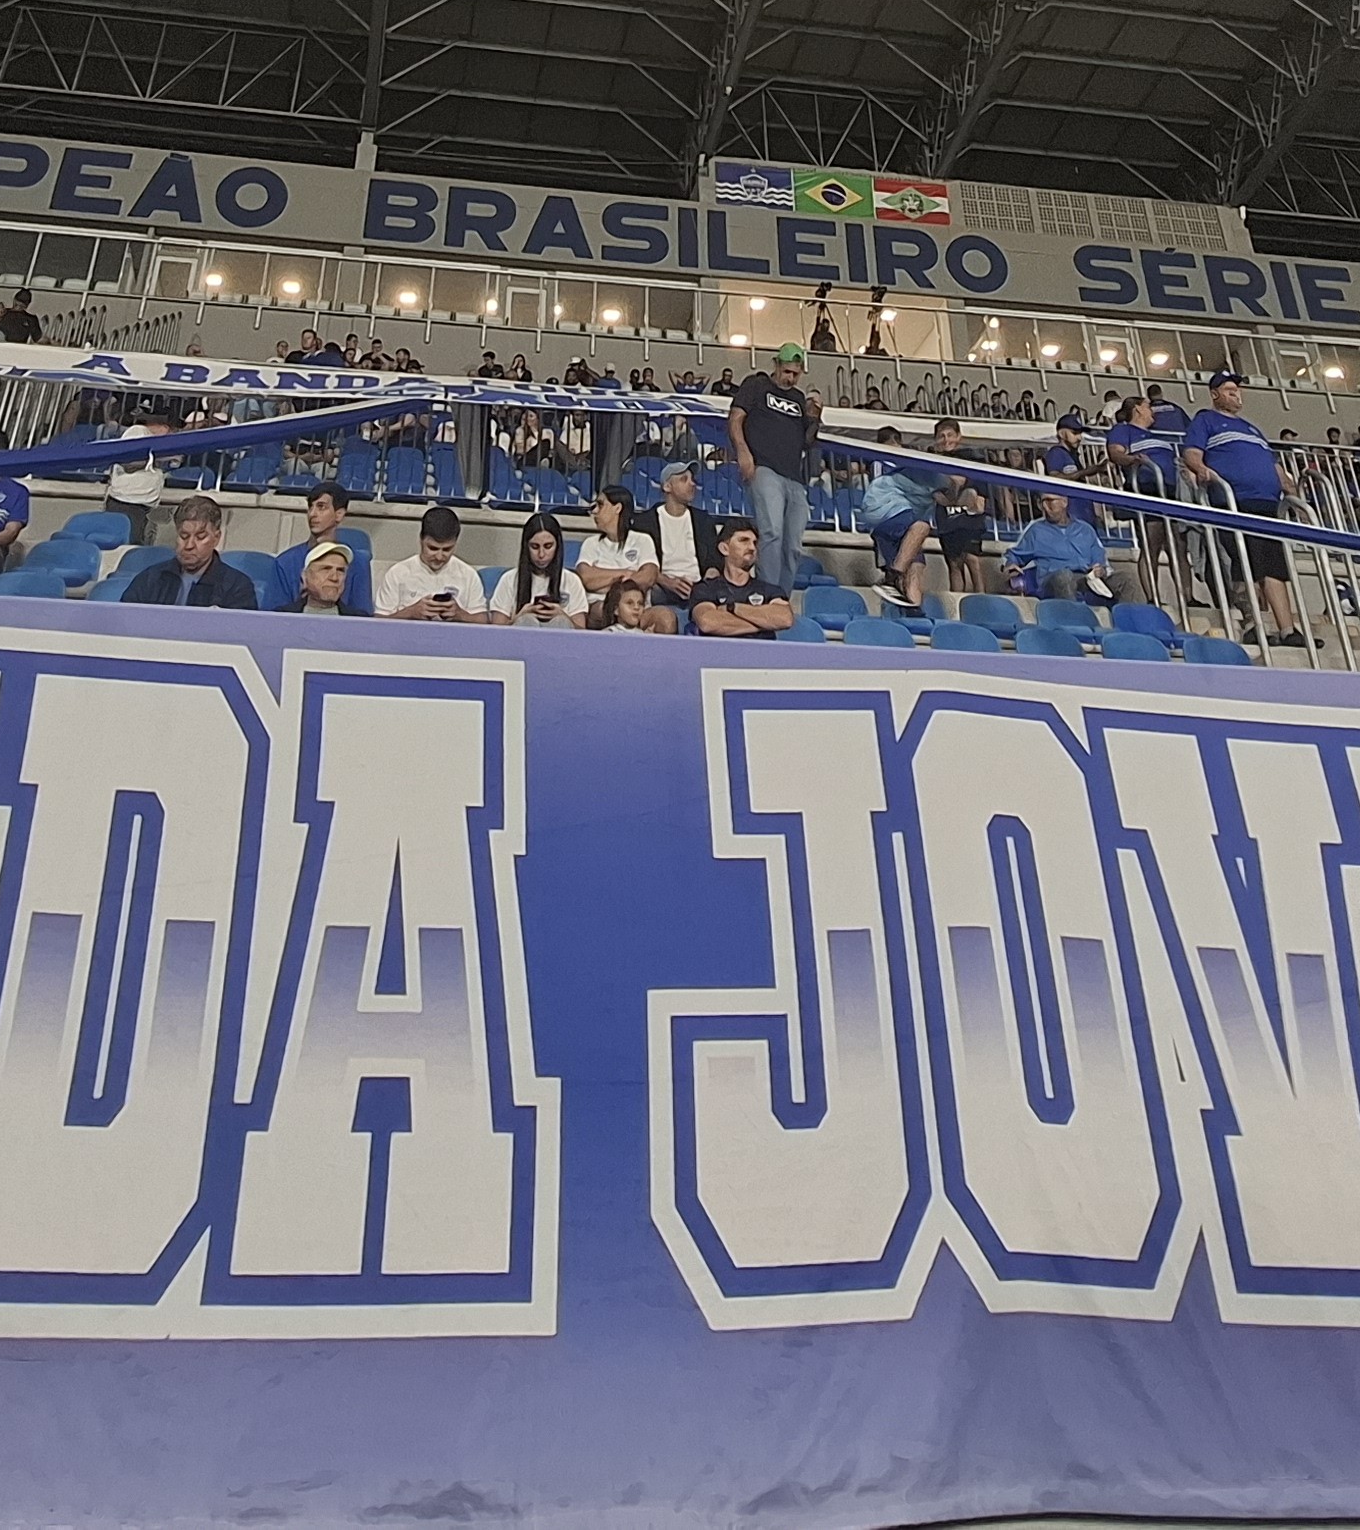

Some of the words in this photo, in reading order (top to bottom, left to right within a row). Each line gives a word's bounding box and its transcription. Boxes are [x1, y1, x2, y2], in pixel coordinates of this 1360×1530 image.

[363, 179, 1009, 293] BRASILEIRO
[72, 354, 131, 376] A
[769, 396, 799, 414] MK
